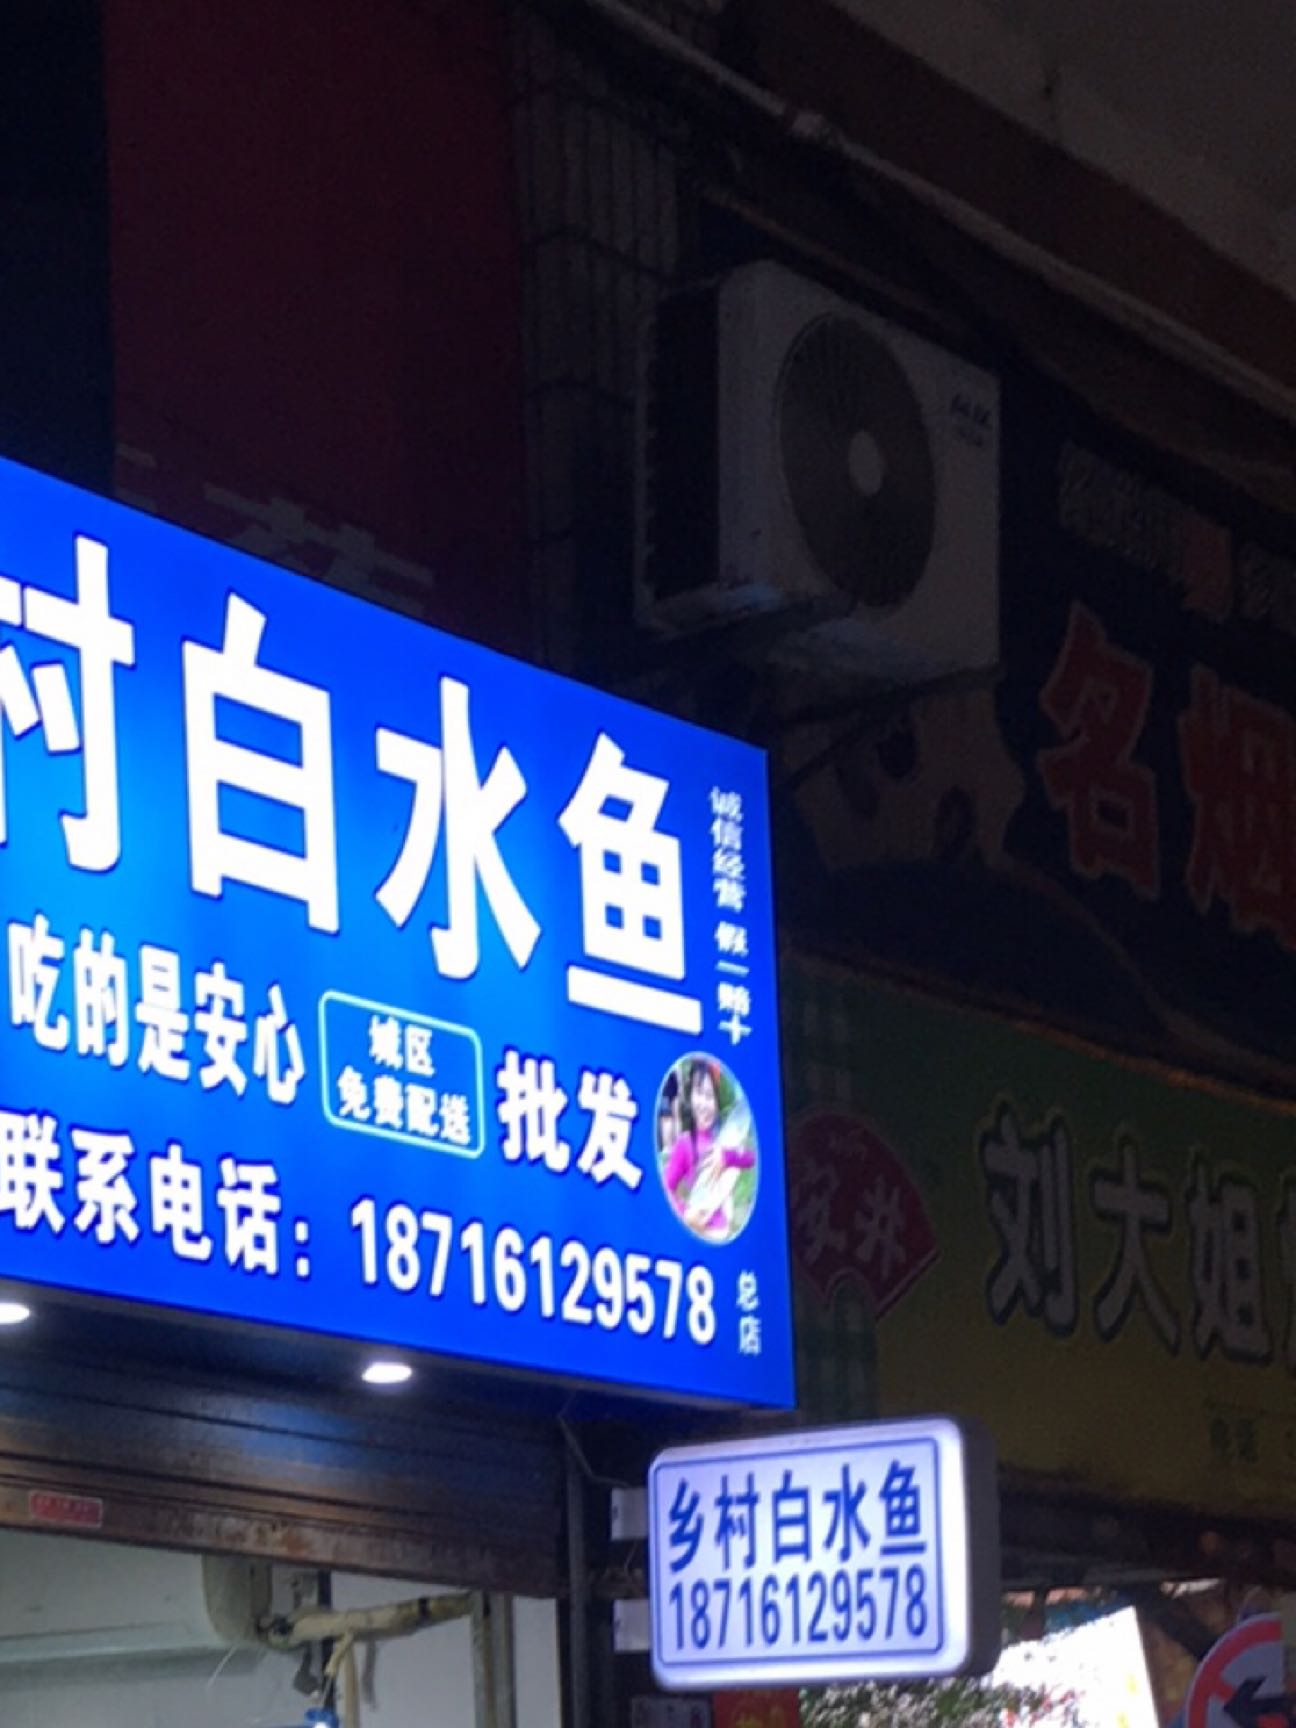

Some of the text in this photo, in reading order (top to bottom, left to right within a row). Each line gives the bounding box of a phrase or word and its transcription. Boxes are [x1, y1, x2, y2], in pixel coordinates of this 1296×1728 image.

[369, 1014, 435, 1078] 城区
[337, 1065, 471, 1146] 免费配送
[497, 1049, 643, 1190] 批发
[352, 1198, 716, 1345] 18716129578
[980, 1100, 1296, 1376] 刘大姐
[737, 1272, 760, 1354] 总店
[668, 1460, 927, 1574] 乡村白水鱼
[668, 1564, 929, 1654] 18716129578
